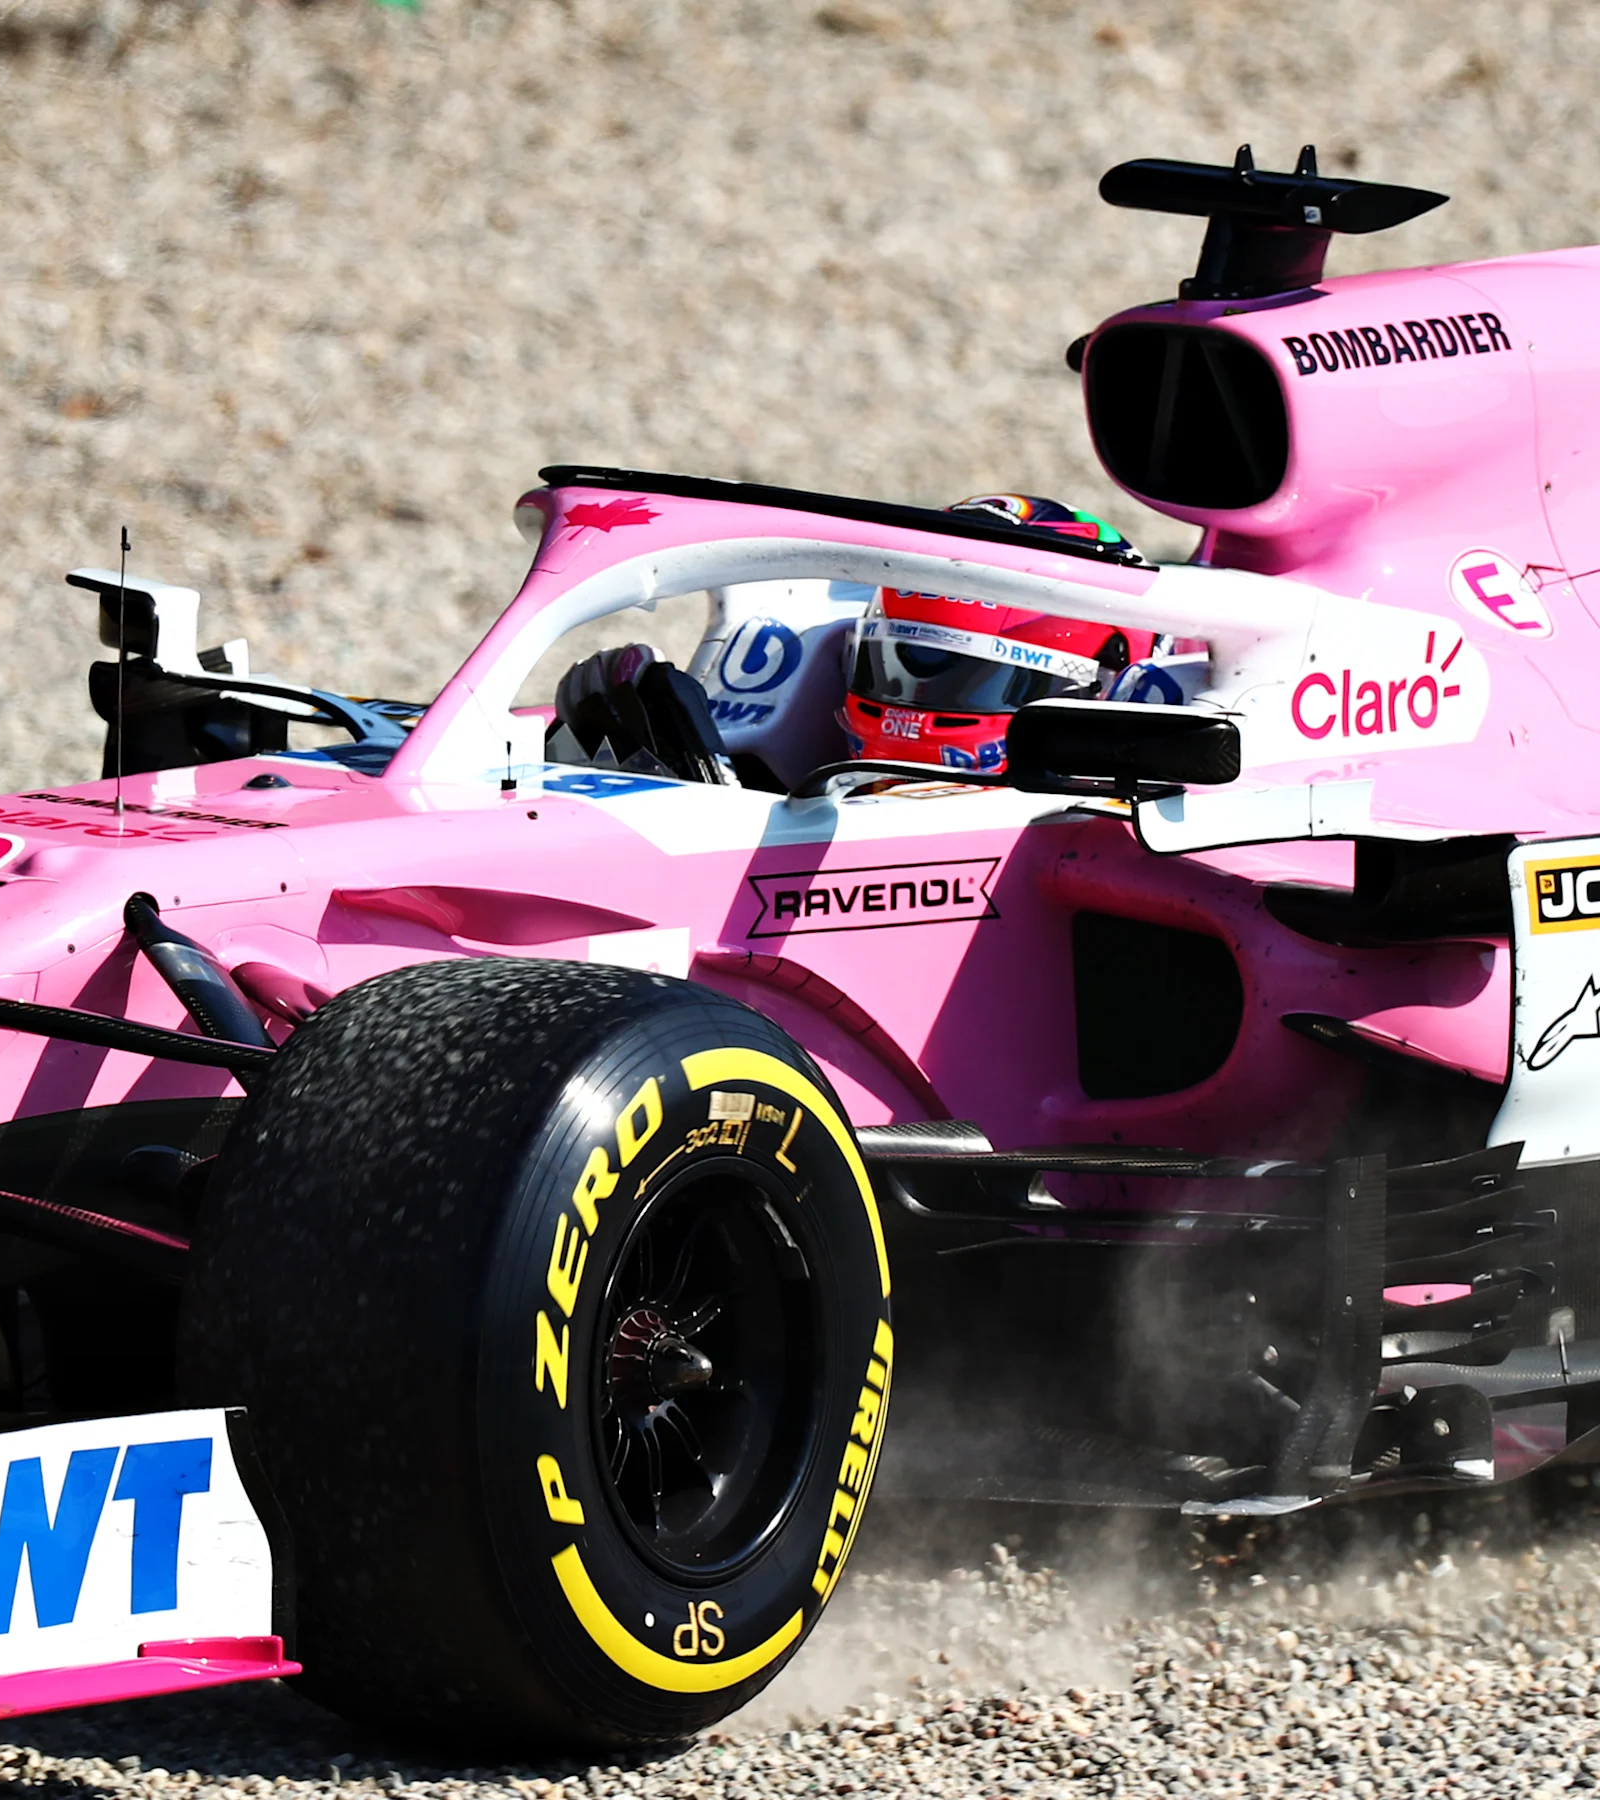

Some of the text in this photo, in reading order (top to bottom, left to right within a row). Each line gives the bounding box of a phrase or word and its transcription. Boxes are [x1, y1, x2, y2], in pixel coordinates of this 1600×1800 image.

[1282, 312, 1512, 376] BOMBARDIER
[1462, 562, 1542, 632] E
[1010, 645, 1053, 669] BWT
[881, 718, 922, 740] ONE
[1291, 669, 1439, 740] Claro
[774, 878, 975, 920] RAVENOL
[536, 1076, 664, 1525] P ZERO
[811, 1318, 894, 1606] PIRELLI
